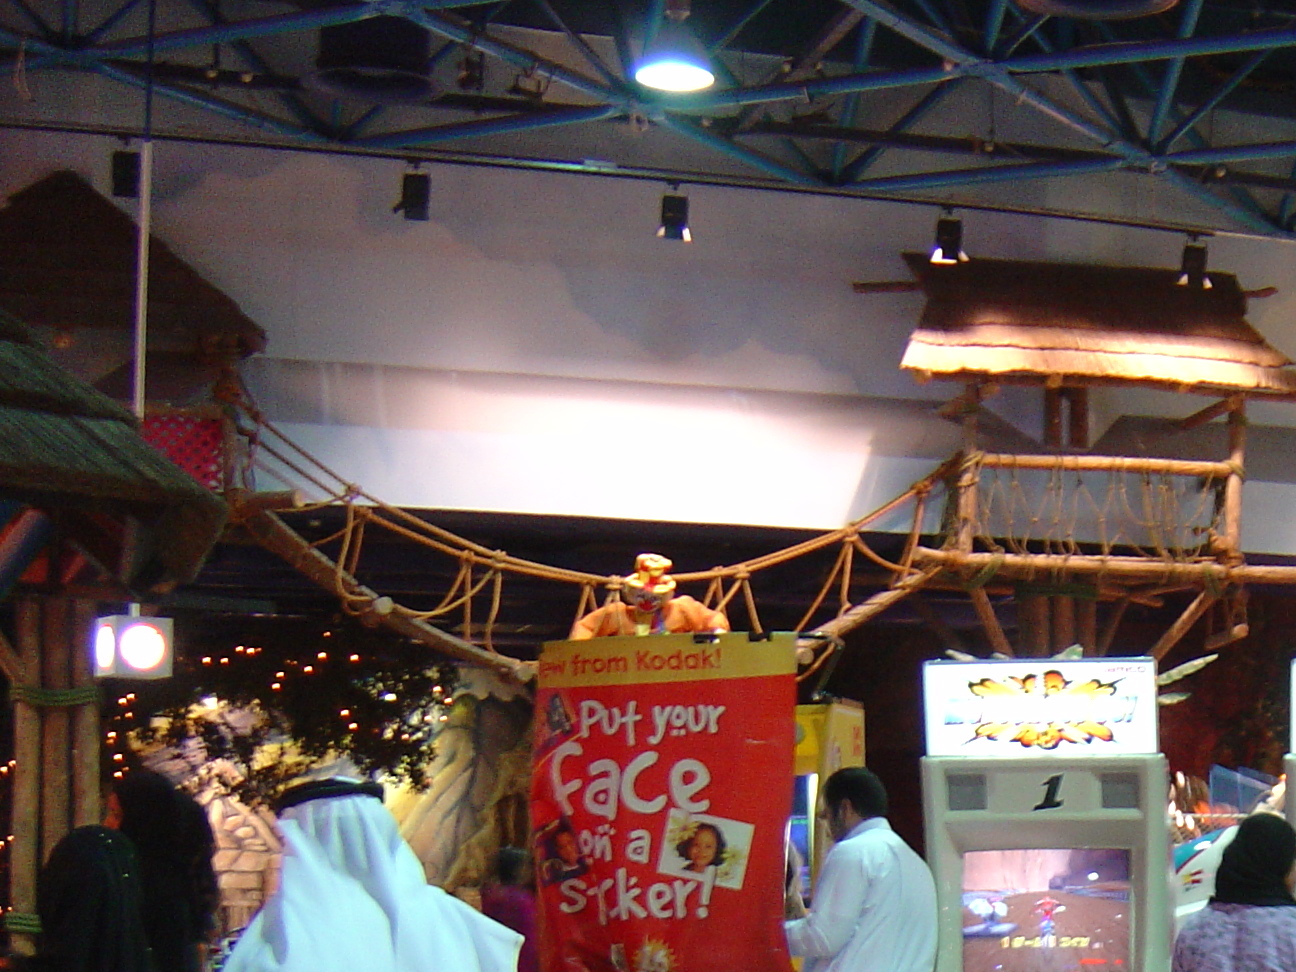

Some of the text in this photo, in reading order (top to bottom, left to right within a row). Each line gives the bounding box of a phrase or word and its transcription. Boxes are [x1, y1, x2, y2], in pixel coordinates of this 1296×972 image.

[540, 648, 721, 678] ew from Kodak!
[580, 700, 726, 746] Put your
[1031, 773, 1065, 811] 1
[625, 829, 651, 863] a
